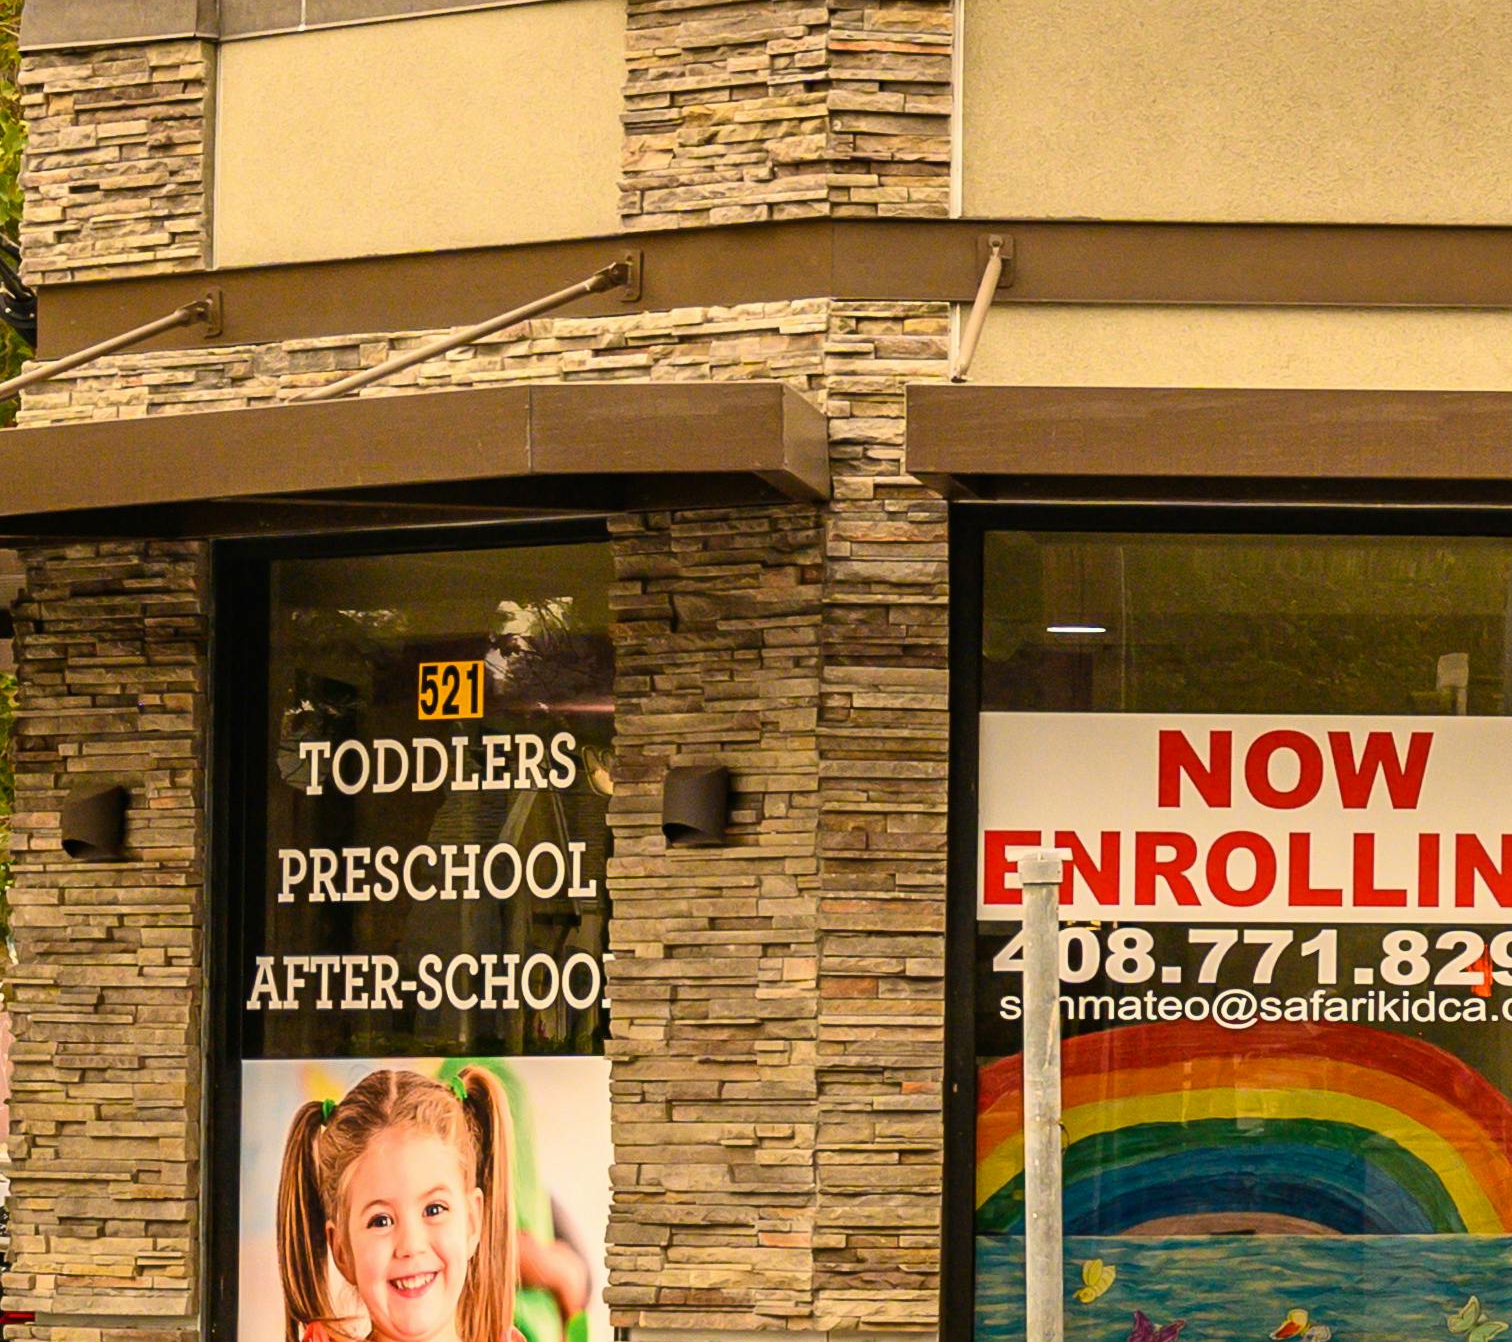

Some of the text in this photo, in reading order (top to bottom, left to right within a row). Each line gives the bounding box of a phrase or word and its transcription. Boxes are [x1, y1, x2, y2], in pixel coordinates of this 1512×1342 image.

[419, 663, 480, 715] 521
[299, 732, 577, 795] TODDLERS
[1157, 729, 1434, 810] NOW
[277, 842, 597, 903] PRESCHOOL
